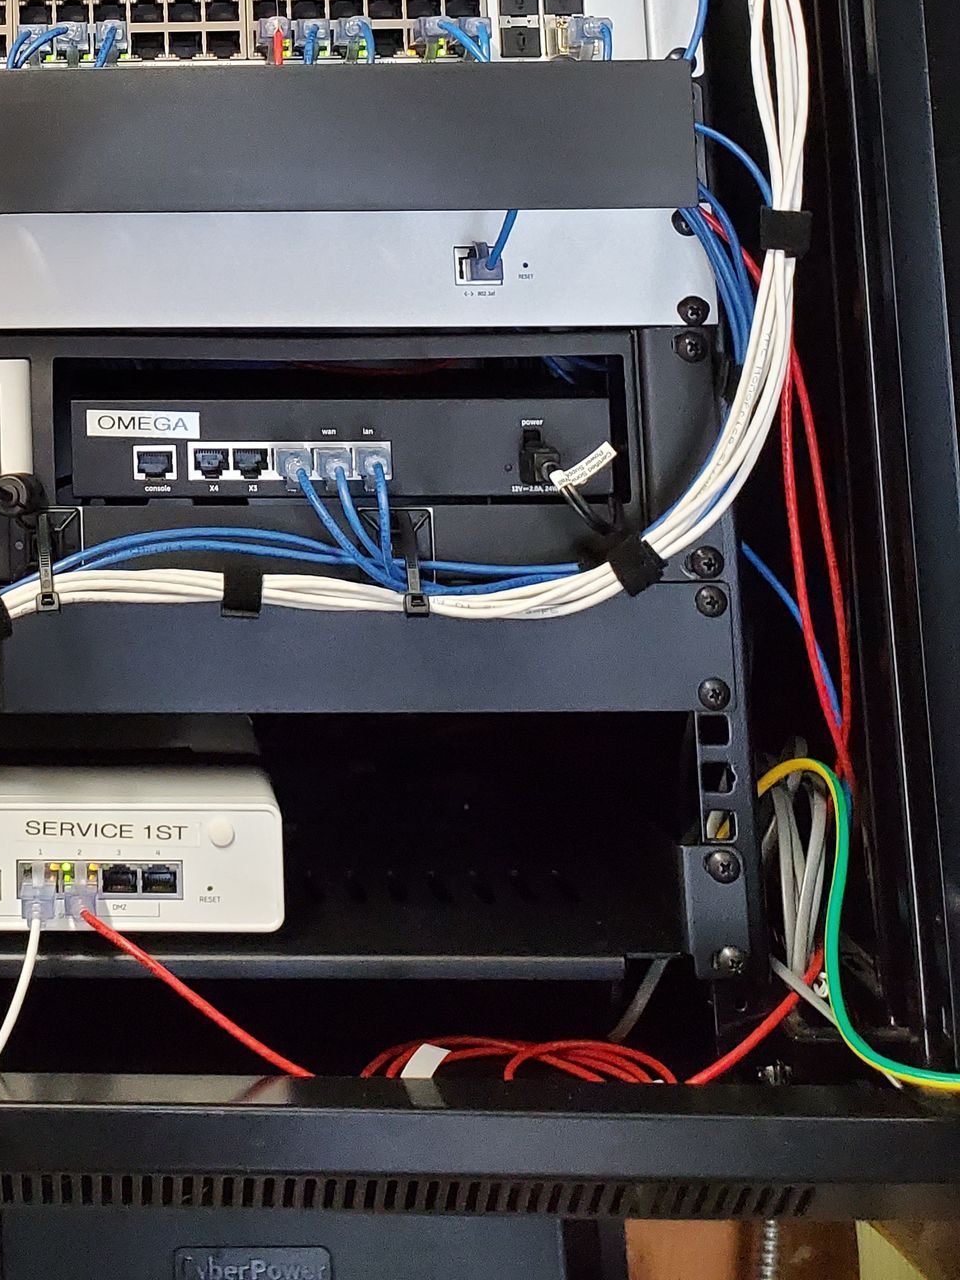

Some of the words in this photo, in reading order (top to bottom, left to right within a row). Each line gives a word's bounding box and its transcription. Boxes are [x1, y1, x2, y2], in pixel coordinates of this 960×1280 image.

[98, 415, 189, 432] OMEGA
[521, 419, 543, 427] power
[362, 427, 374, 435] lan
[586, 450, 604, 466] Power
[588, 452, 611, 472] Certified
[144, 484, 171, 492] console
[209, 484, 219, 492] X4
[248, 484, 258, 492] X3
[25, 819, 134, 840] SERVICE
[143, 824, 189, 841] 1ST
